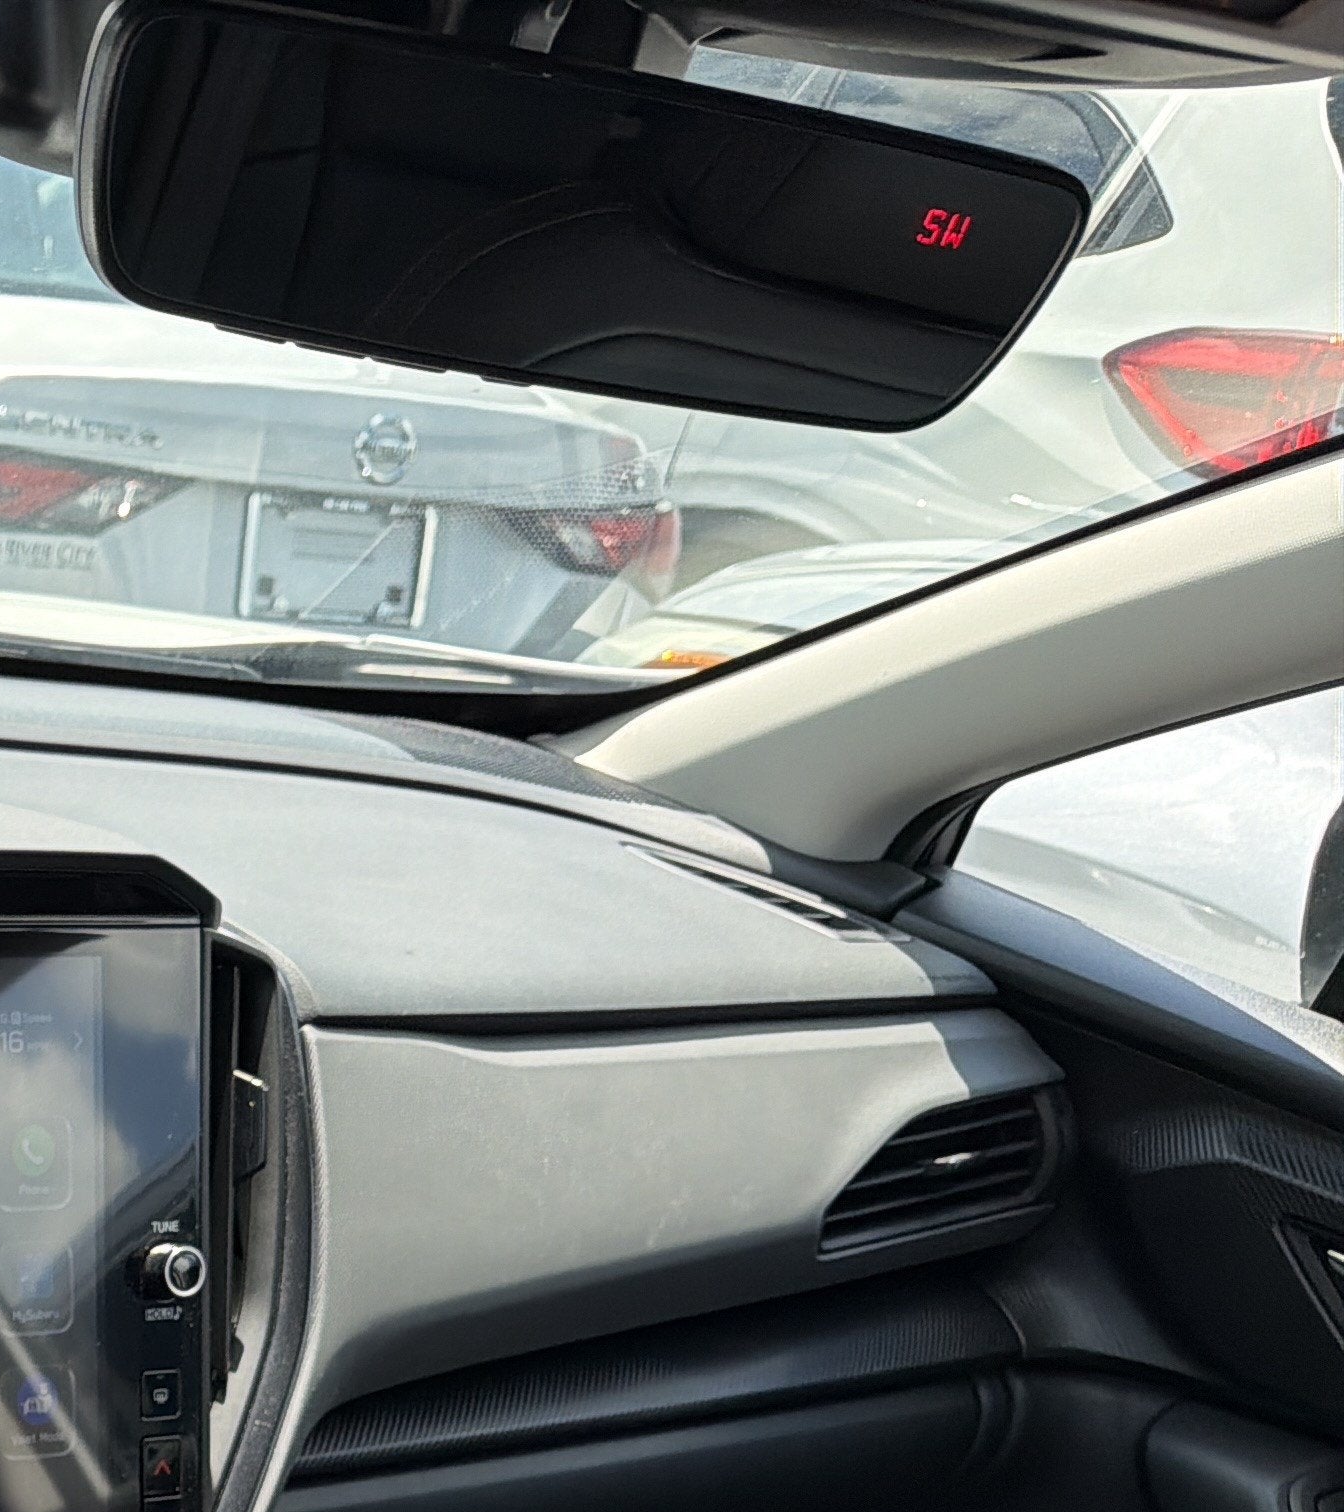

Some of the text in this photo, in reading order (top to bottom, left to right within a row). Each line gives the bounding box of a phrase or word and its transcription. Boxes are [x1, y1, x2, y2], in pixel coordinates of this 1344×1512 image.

[916, 209, 971, 249] SW
[0, 1031, 25, 1054] 16
[151, 1221, 180, 1233] TUNE
